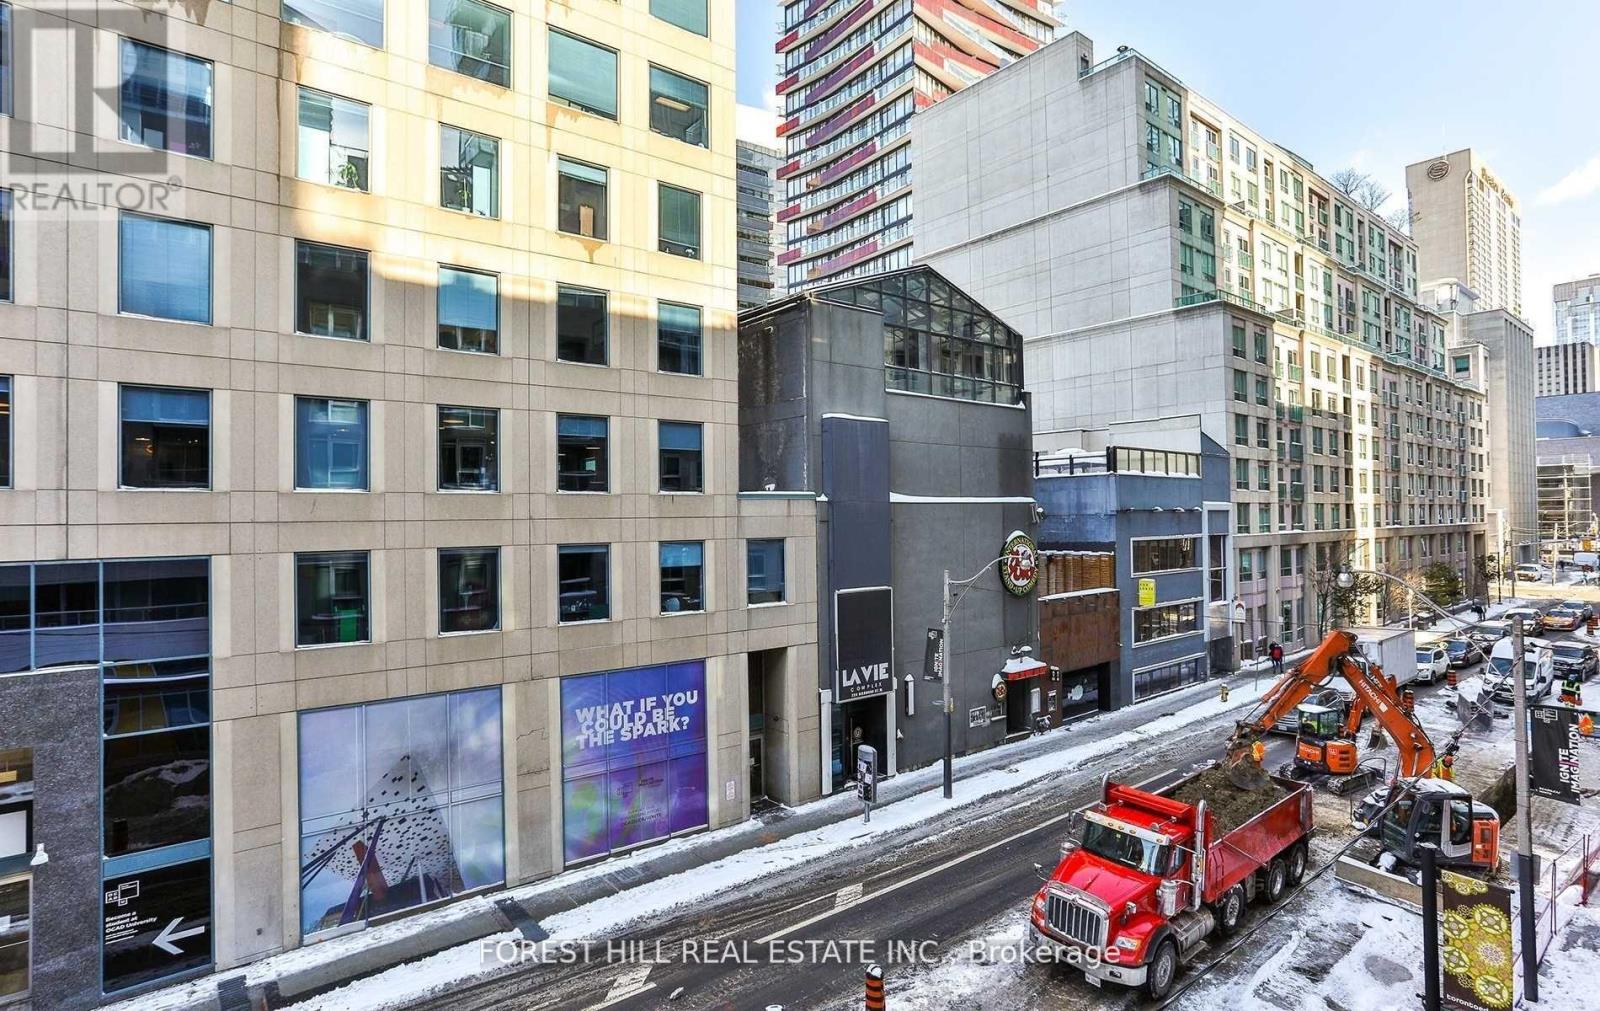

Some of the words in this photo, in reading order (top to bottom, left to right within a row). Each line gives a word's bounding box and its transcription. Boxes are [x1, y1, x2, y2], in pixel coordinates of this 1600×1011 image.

[860, 662, 889, 682] VIE
[1358, 679, 1382, 705] HITACHI
[575, 700, 634, 723] WHAT
[640, 696, 657, 712] IF
[662, 690, 698, 707] YOU
[575, 730, 615, 750] THE
[620, 716, 690, 742] SPARK?
[581, 711, 646, 736] COULD
[652, 706, 675, 723] BE
[105, 924, 126, 933] OCAD
